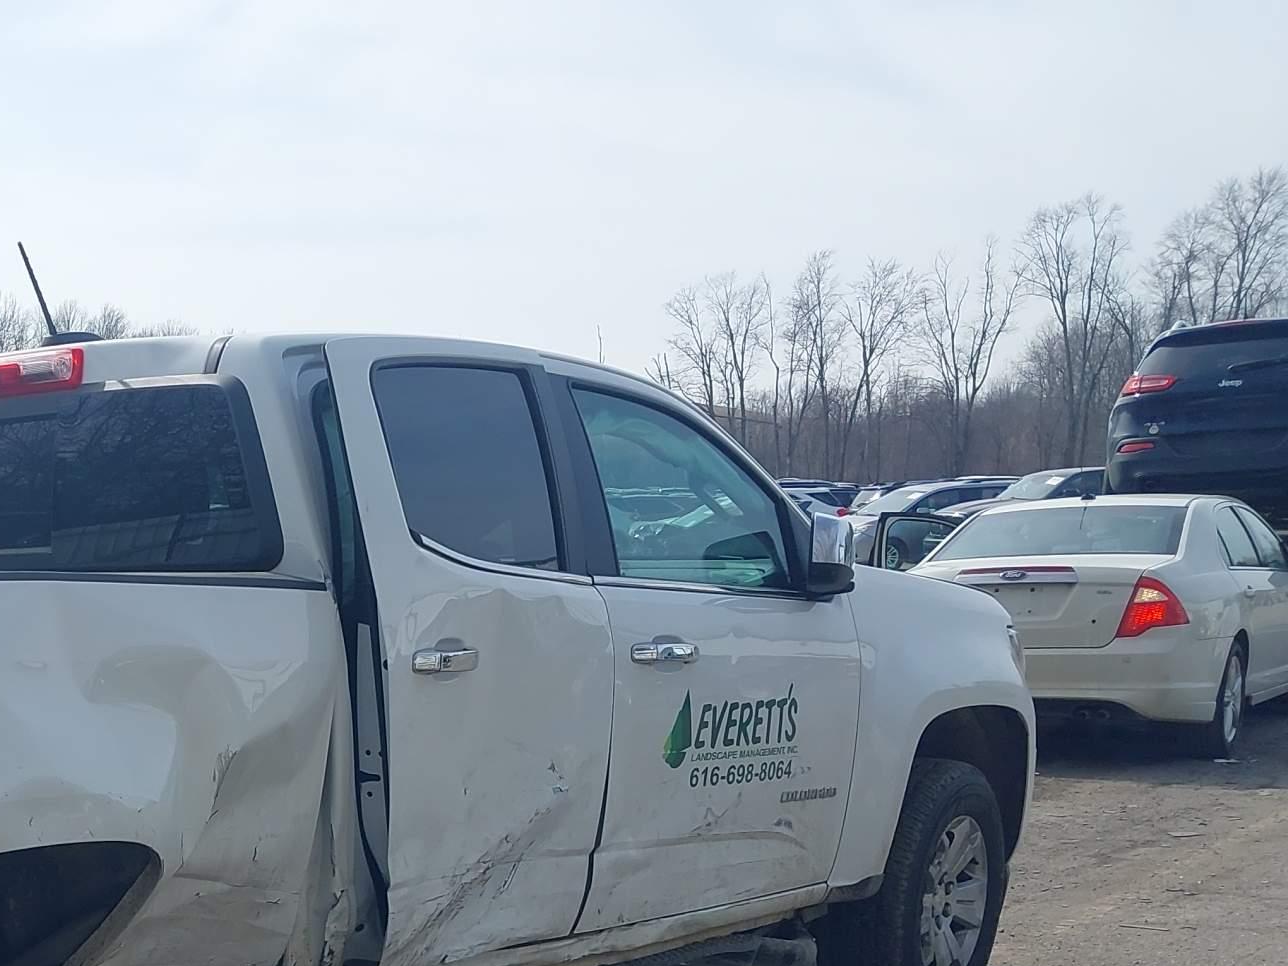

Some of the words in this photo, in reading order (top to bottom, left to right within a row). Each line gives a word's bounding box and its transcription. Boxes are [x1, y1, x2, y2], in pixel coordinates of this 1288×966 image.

[1218, 379, 1243, 388] Jeep
[693, 682, 798, 750] EVERETT'S
[691, 750, 738, 762] LANDSCAPE
[689, 759, 792, 788] 616-698-8064
